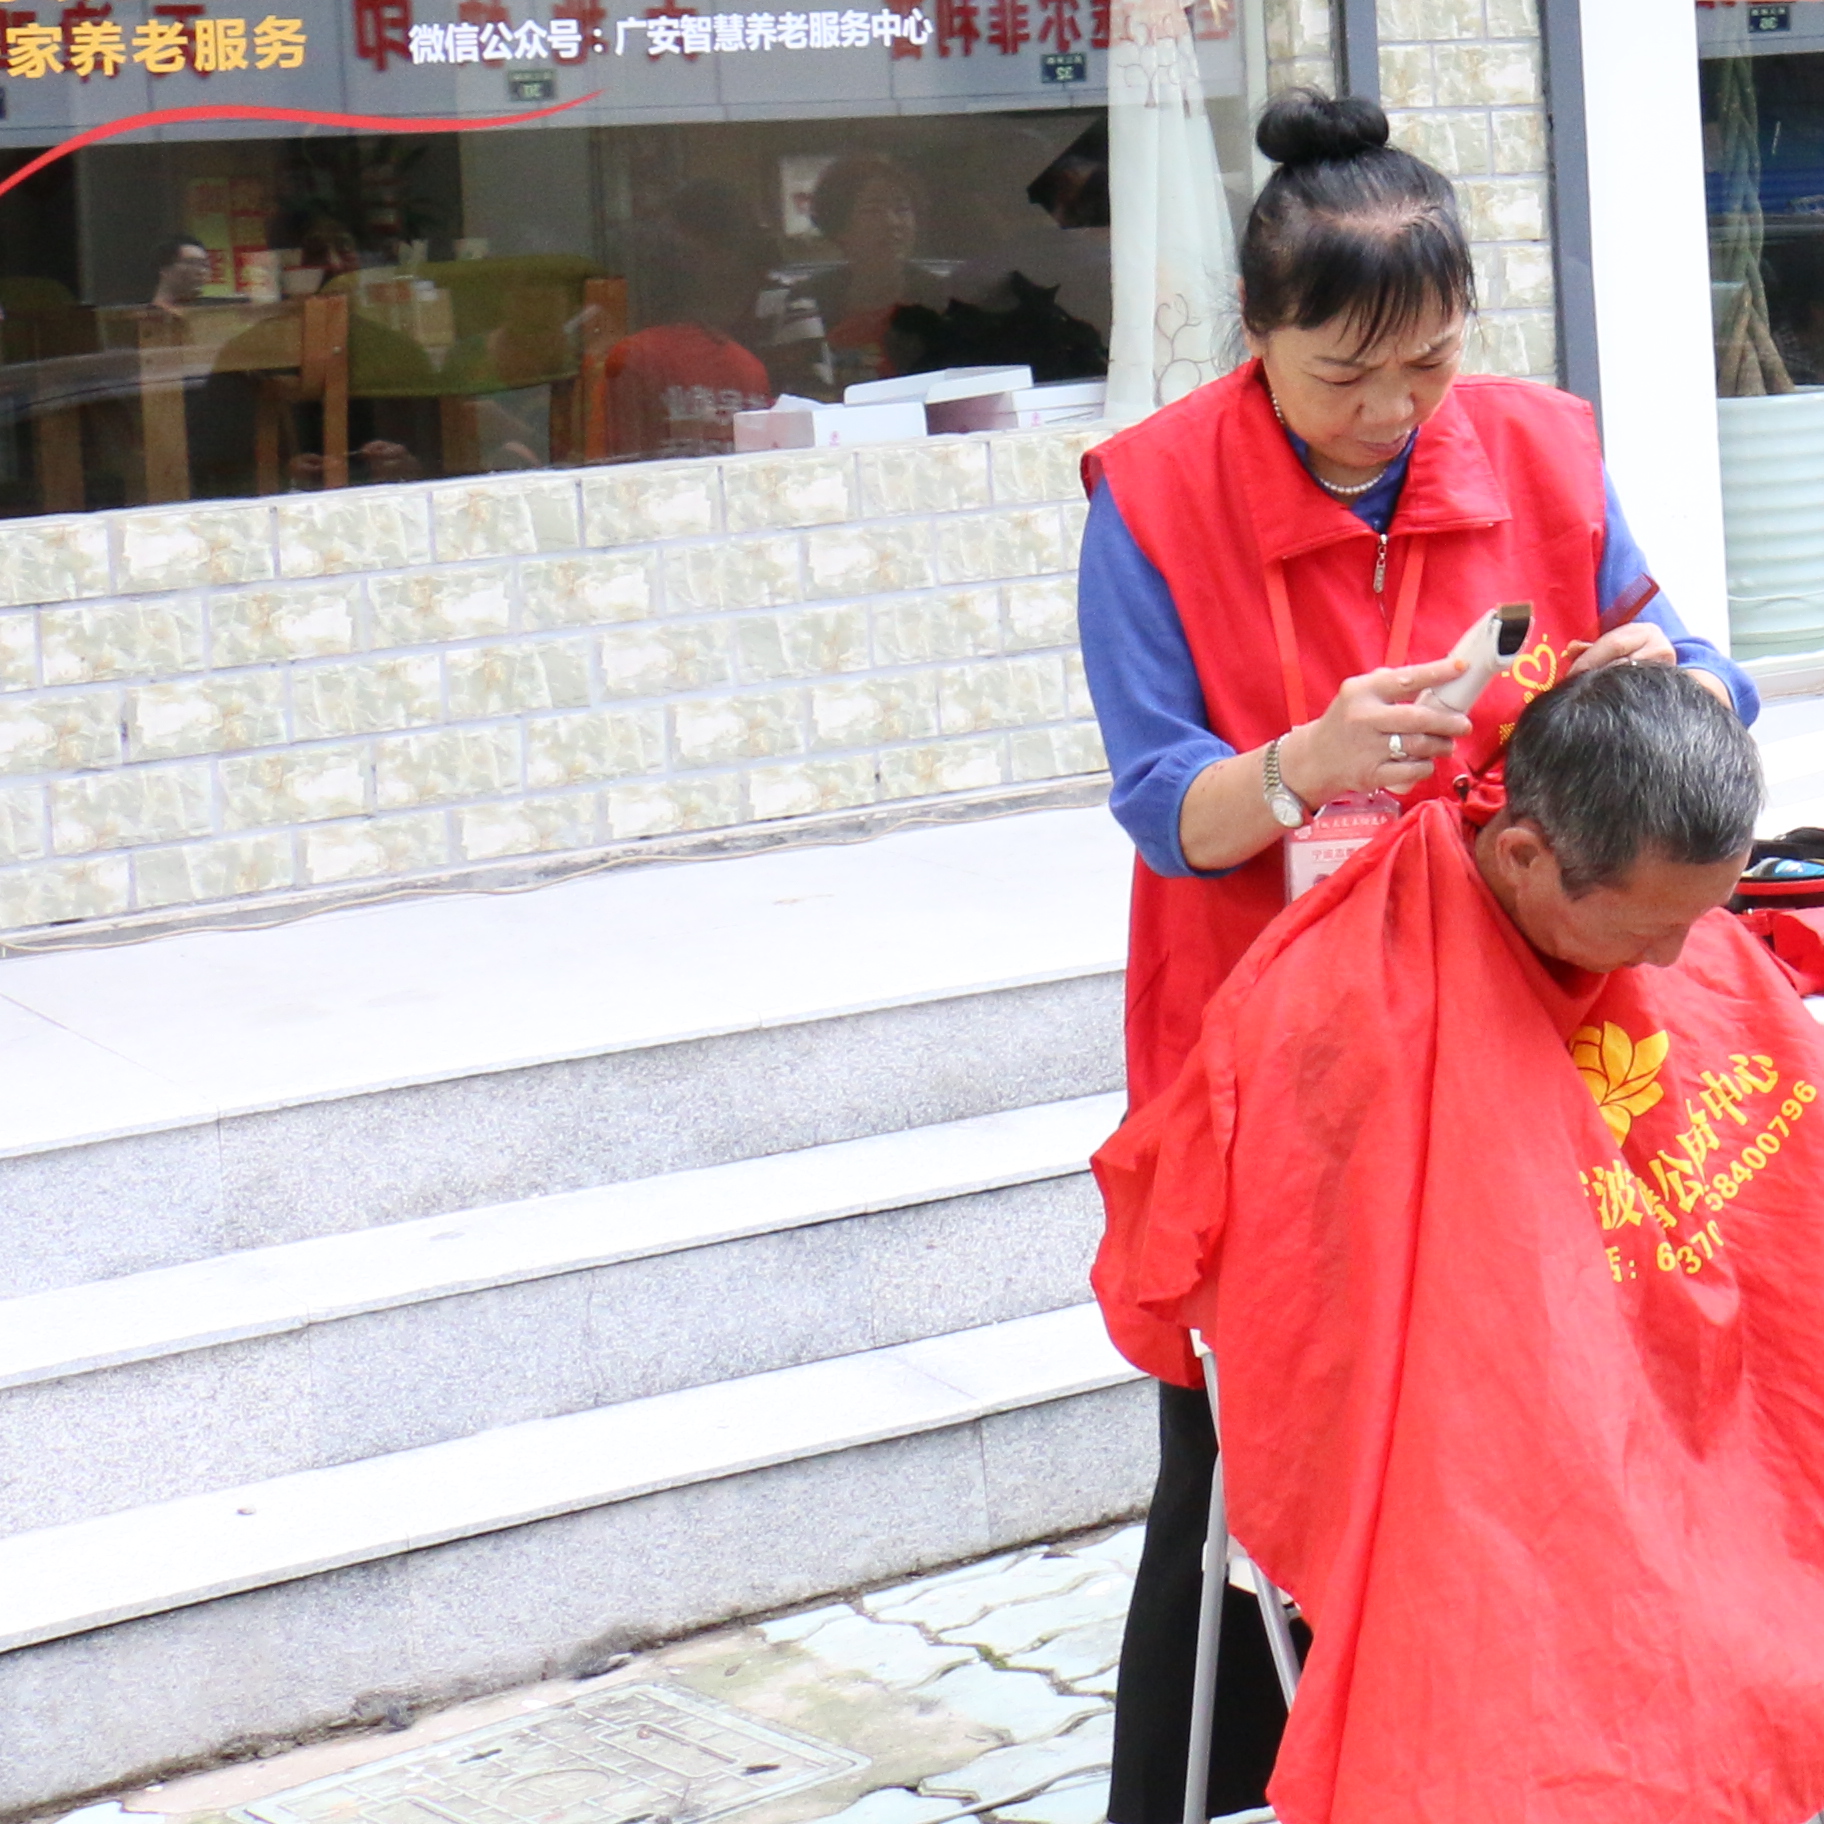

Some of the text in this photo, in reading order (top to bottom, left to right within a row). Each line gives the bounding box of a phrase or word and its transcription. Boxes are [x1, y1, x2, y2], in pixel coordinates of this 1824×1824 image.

[5, 15, 308, 79] 家养老服务
[408, 8, 933, 65] 微信公众号：广安智慧养老服务中心
